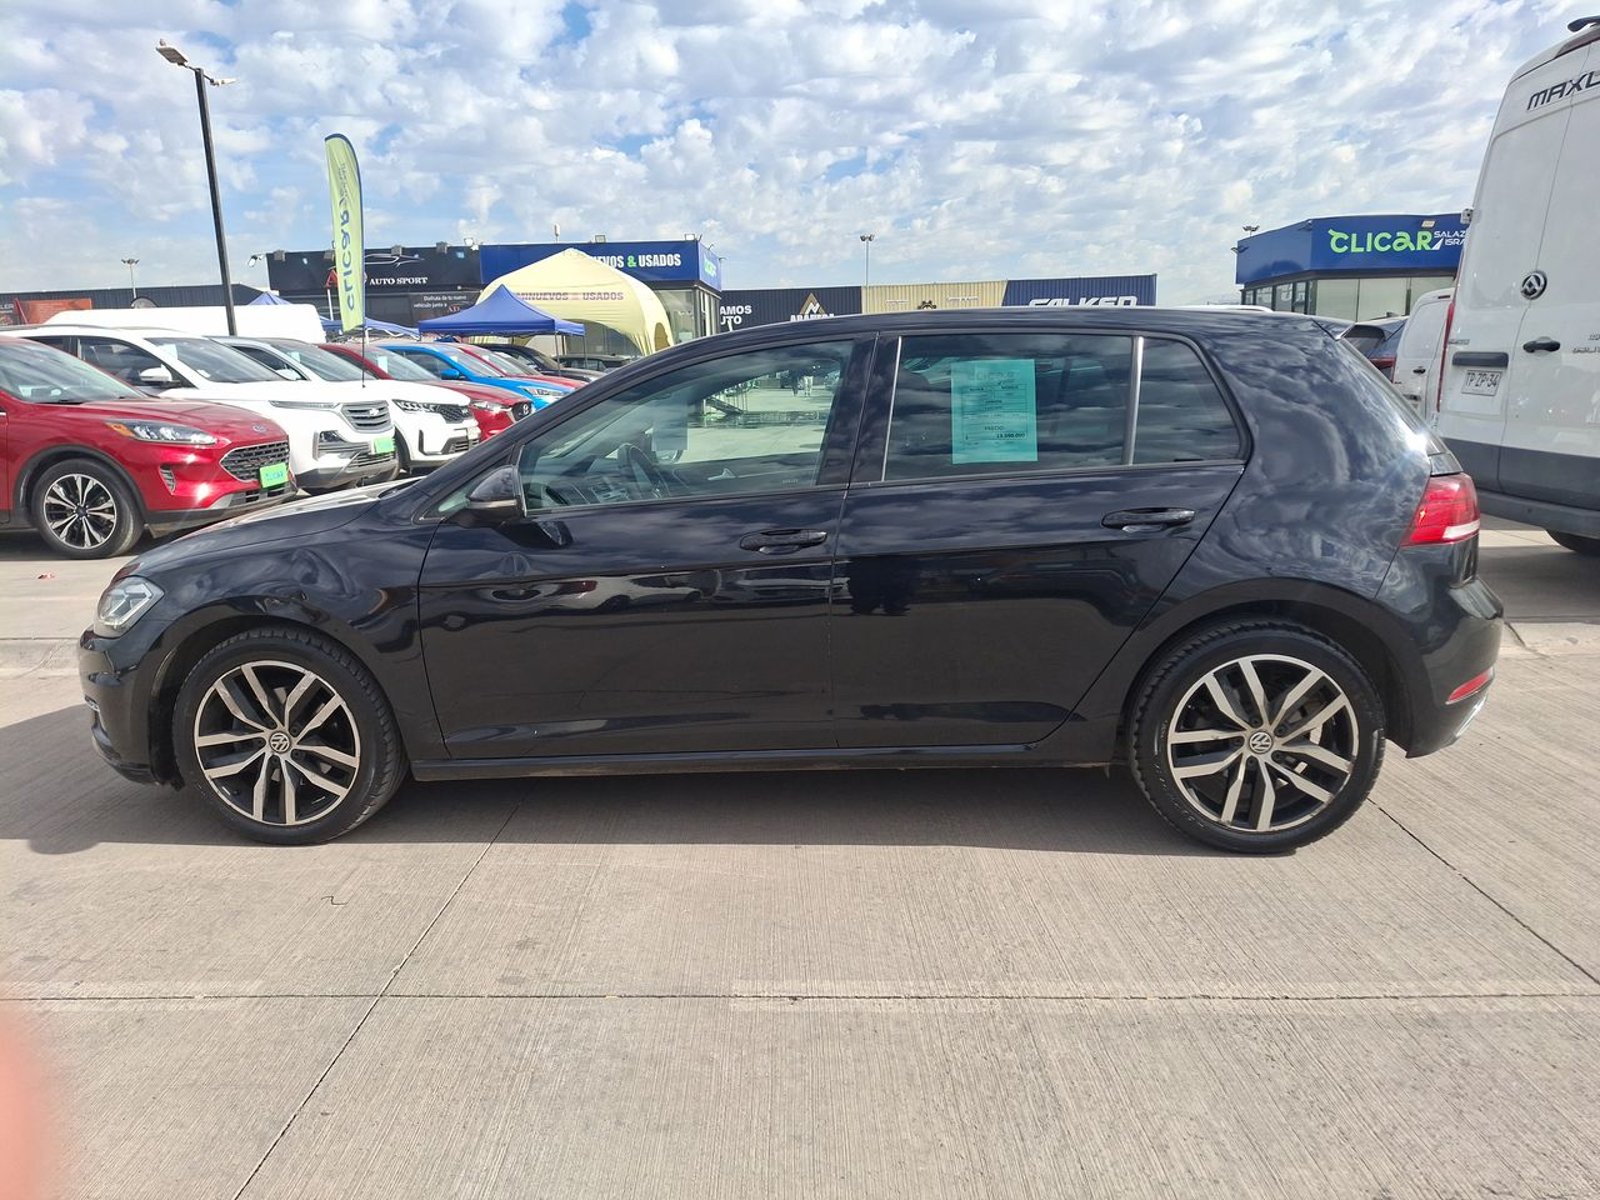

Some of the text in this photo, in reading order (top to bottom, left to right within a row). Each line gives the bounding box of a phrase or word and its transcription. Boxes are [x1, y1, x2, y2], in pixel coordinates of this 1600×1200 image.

[627, 255, 637, 268] &
[638, 253, 682, 267] USADOS
[369, 276, 428, 286] AUTO SPORT
[582, 291, 625, 301] USADOS
[720, 304, 752, 315] AMOS
